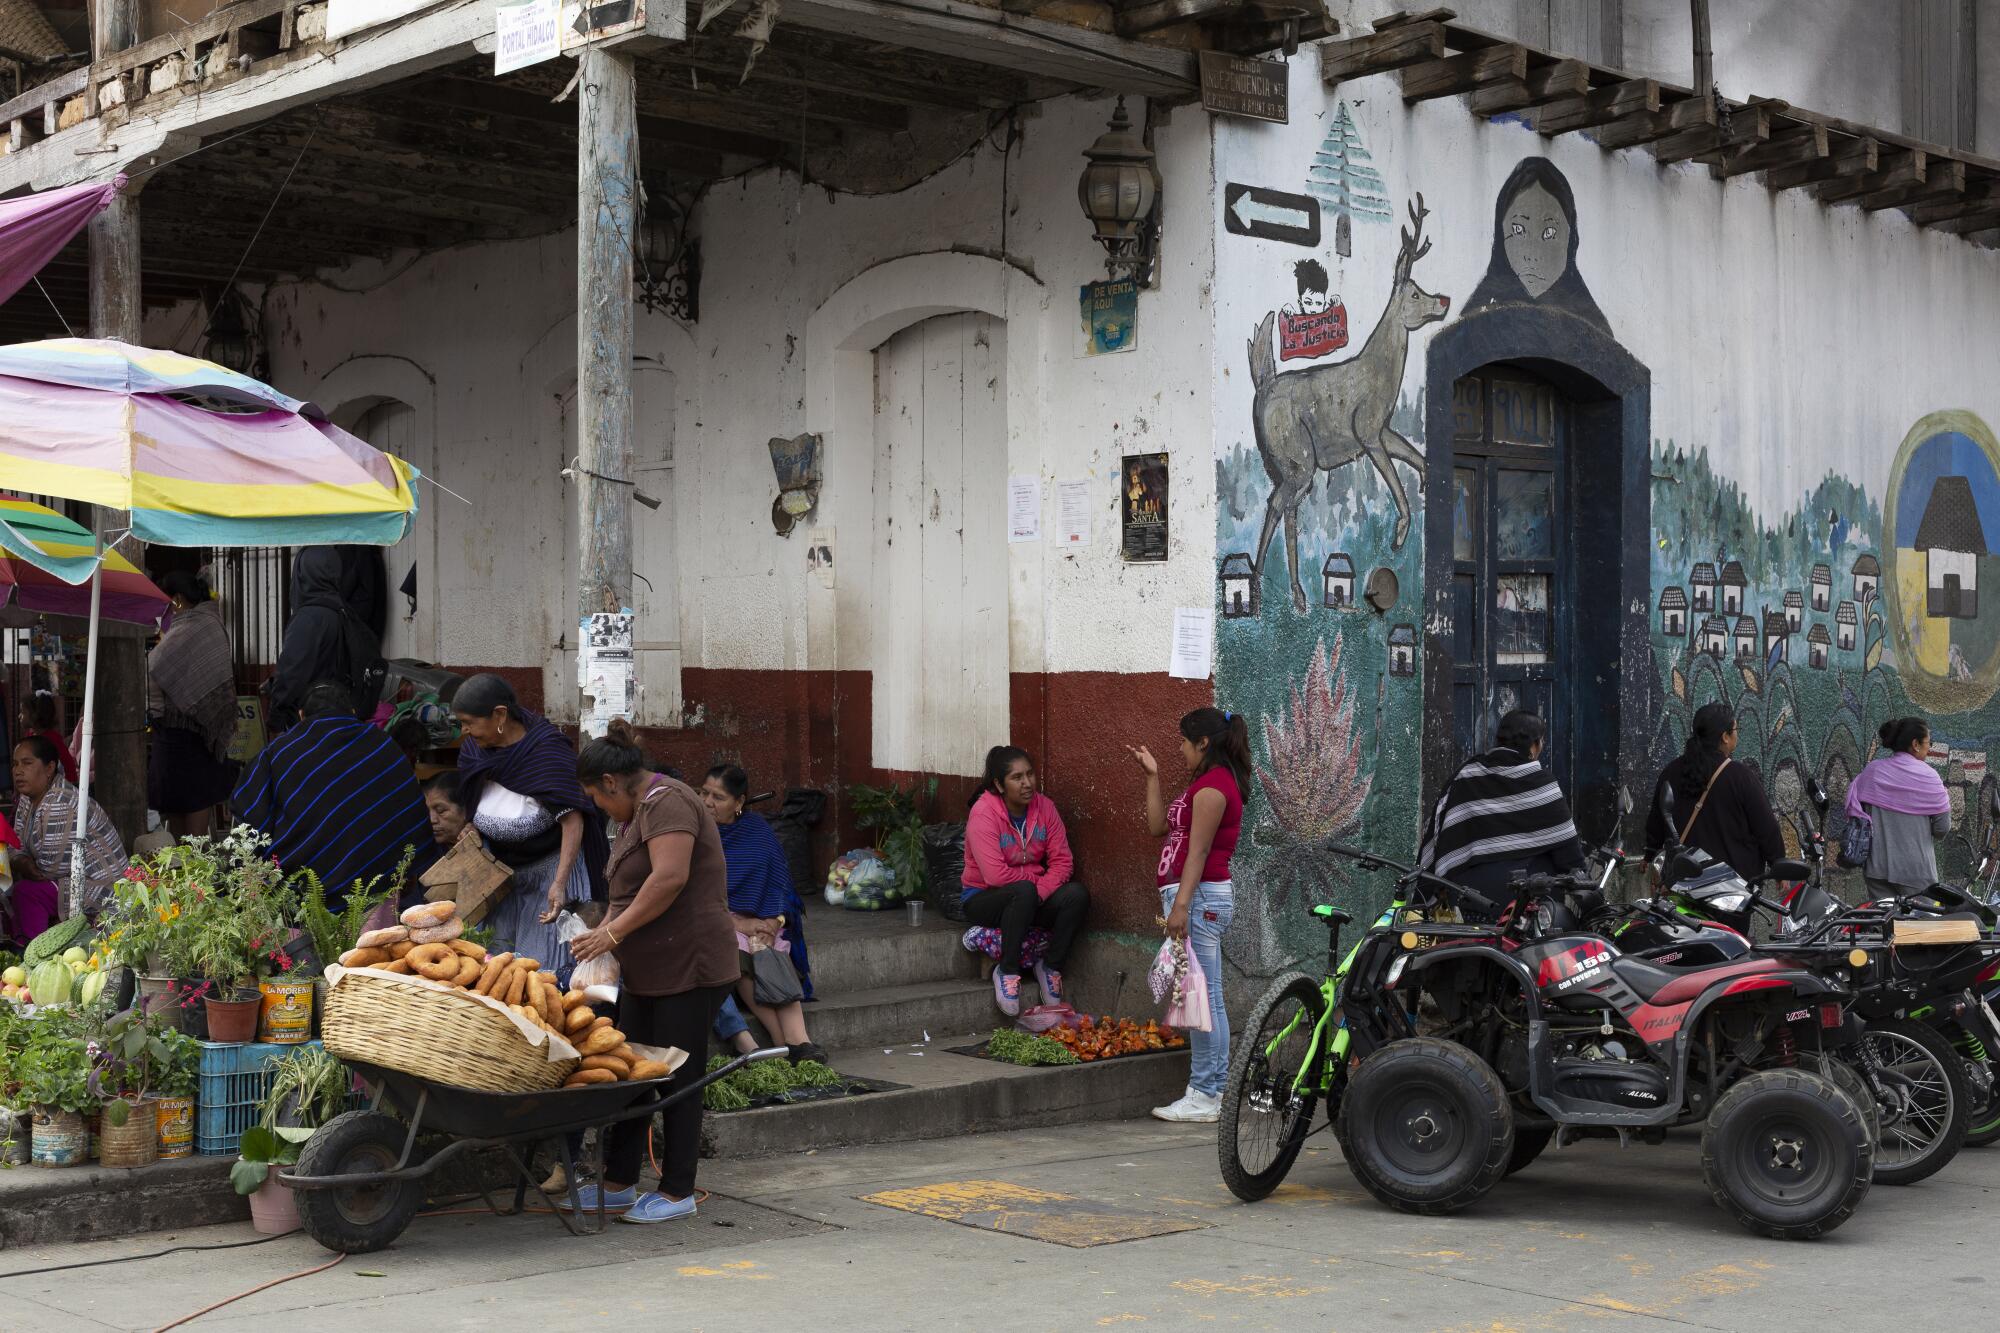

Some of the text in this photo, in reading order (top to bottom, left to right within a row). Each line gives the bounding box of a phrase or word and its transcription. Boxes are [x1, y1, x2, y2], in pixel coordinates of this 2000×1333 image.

[502, 31, 526, 55] PORTAL
[527, 19, 555, 47] HIDALGO
[1230, 59, 1261, 74] AVENIDA
[1204, 71, 1271, 98] INDEPENDENCIA
[1094, 282, 1134, 298] DE VENTA
[1288, 309, 1340, 333] Buscando
[1282, 329, 1346, 349] La Justicia
[1131, 511, 1159, 523] SANTA
[1573, 951, 1611, 972] 150
